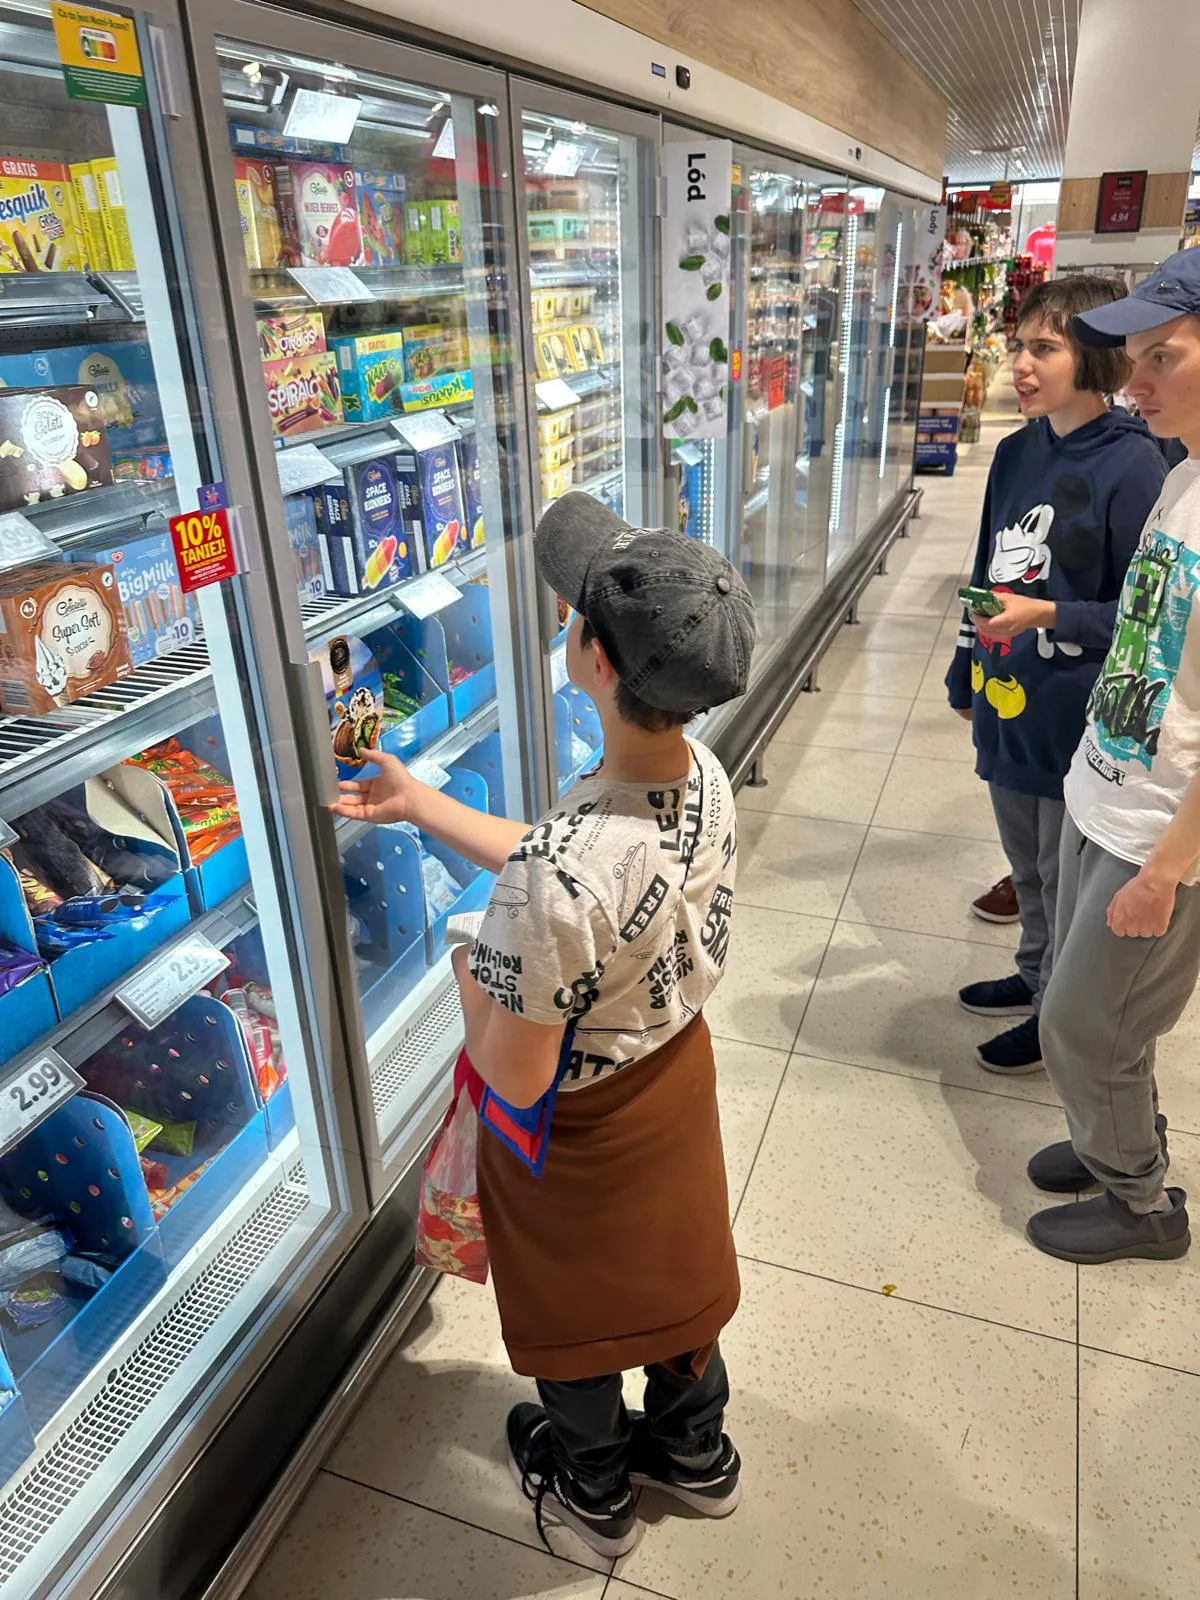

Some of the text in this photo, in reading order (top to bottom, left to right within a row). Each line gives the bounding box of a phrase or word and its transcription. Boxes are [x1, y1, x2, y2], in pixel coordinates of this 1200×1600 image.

[2, 161, 38, 176] GRATIS
[687, 153, 706, 202] Lód
[267, 377, 321, 413] SPIRALO
[366, 482, 388, 499] SPACE
[175, 513, 222, 549] 10%
[180, 538, 227, 566] TANIEJ!
[52, 612, 101, 645] Super Soft
[706, 782, 716, 838] CHOOSE
[624, 882, 665, 938] FREE
[10, 1062, 61, 1112] 2.99
[609, 1490, 632, 1513] Reebok
